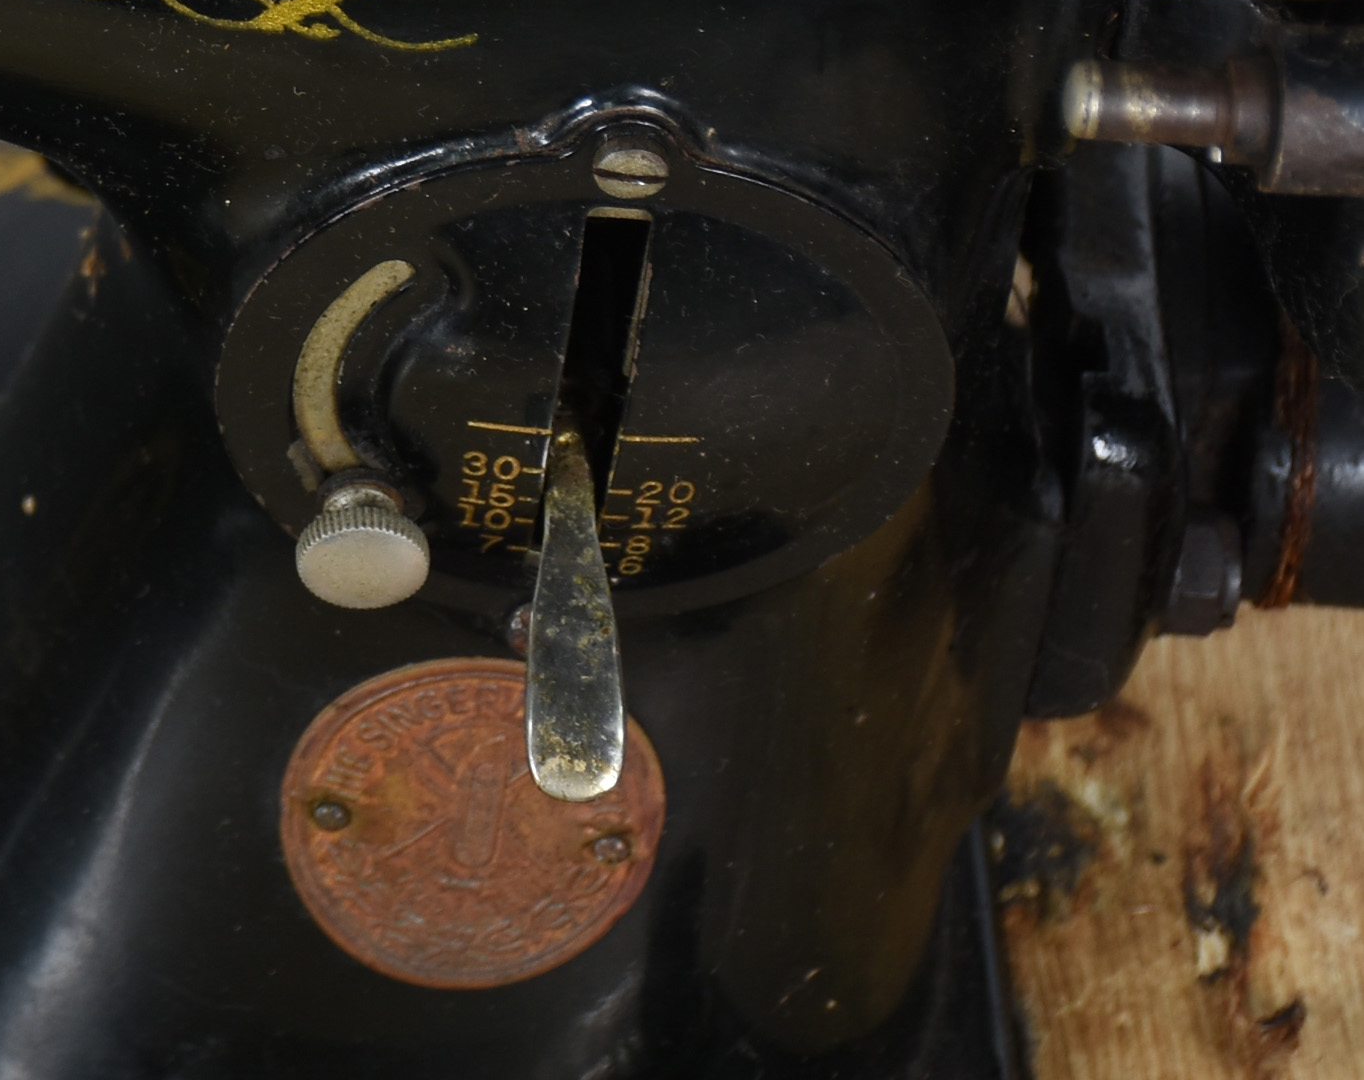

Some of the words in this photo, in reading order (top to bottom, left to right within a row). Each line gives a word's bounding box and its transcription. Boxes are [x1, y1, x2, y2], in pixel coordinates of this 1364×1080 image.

[461, 450, 521, 480] 30
[458, 479, 516, 508] 15
[636, 481, 695, 505] 20
[458, 503, 512, 530] 10
[631, 507, 691, 530] 12
[480, 535, 504, 554] 7
[625, 535, 651, 556] 8
[618, 556, 643, 576] 6
[357, 683, 499, 751] SINGER
